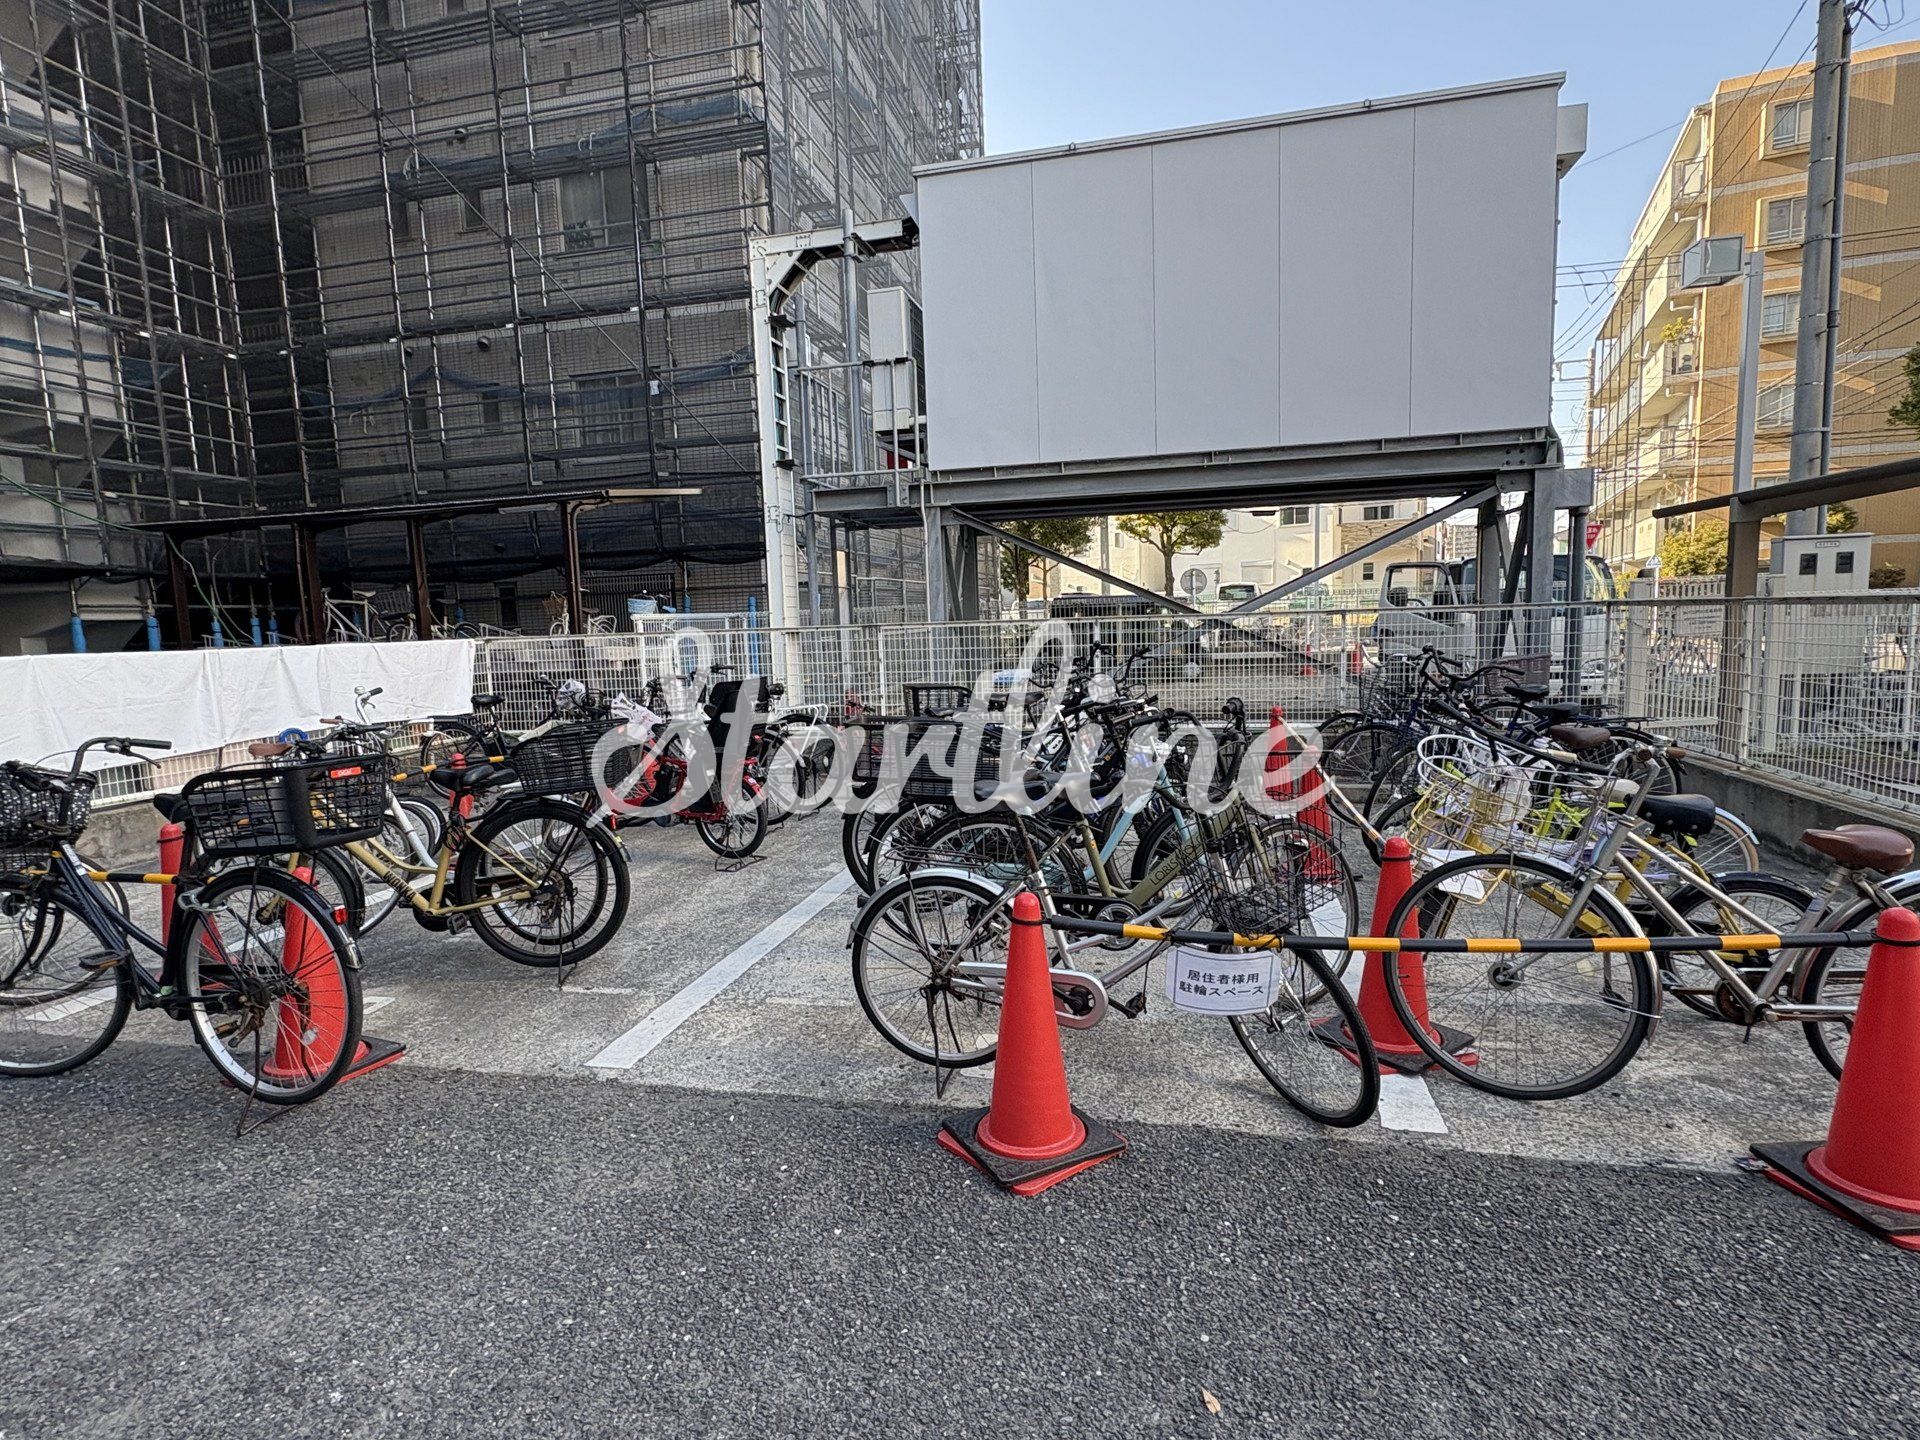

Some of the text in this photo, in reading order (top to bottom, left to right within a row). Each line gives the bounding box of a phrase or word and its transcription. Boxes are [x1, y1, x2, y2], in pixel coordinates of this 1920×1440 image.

[1187, 969, 1260, 985] 居住者様用
[1178, 980, 1265, 996] 駐輪スペース
